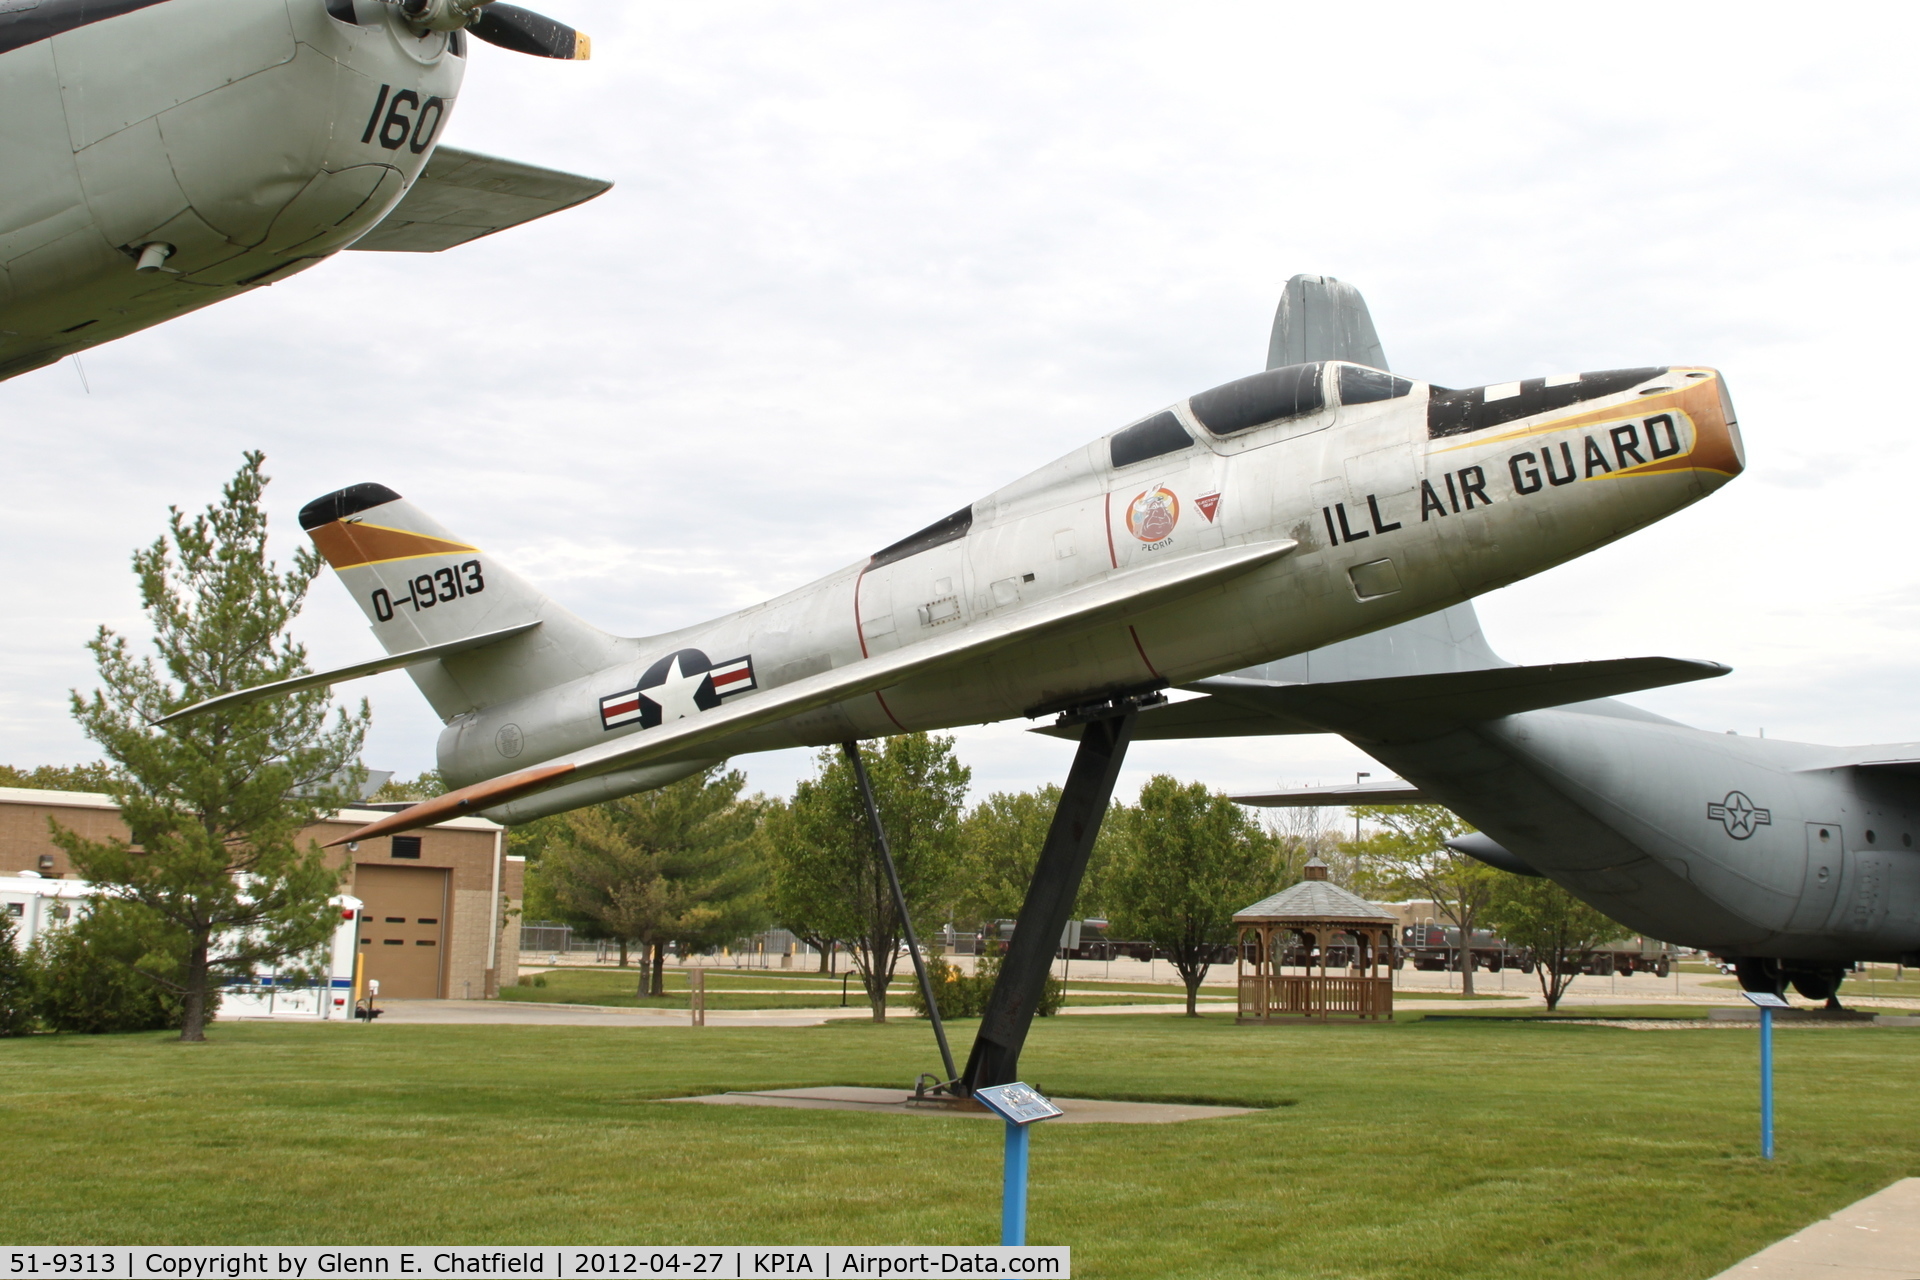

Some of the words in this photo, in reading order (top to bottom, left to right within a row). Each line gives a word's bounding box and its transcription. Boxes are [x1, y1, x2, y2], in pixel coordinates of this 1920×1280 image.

[361, 84, 444, 154] 160
[1322, 494, 1402, 547] ILL
[1421, 465, 1494, 523] AIR
[1507, 413, 1681, 495] GUARD
[1141, 537, 1174, 551] PEORIA
